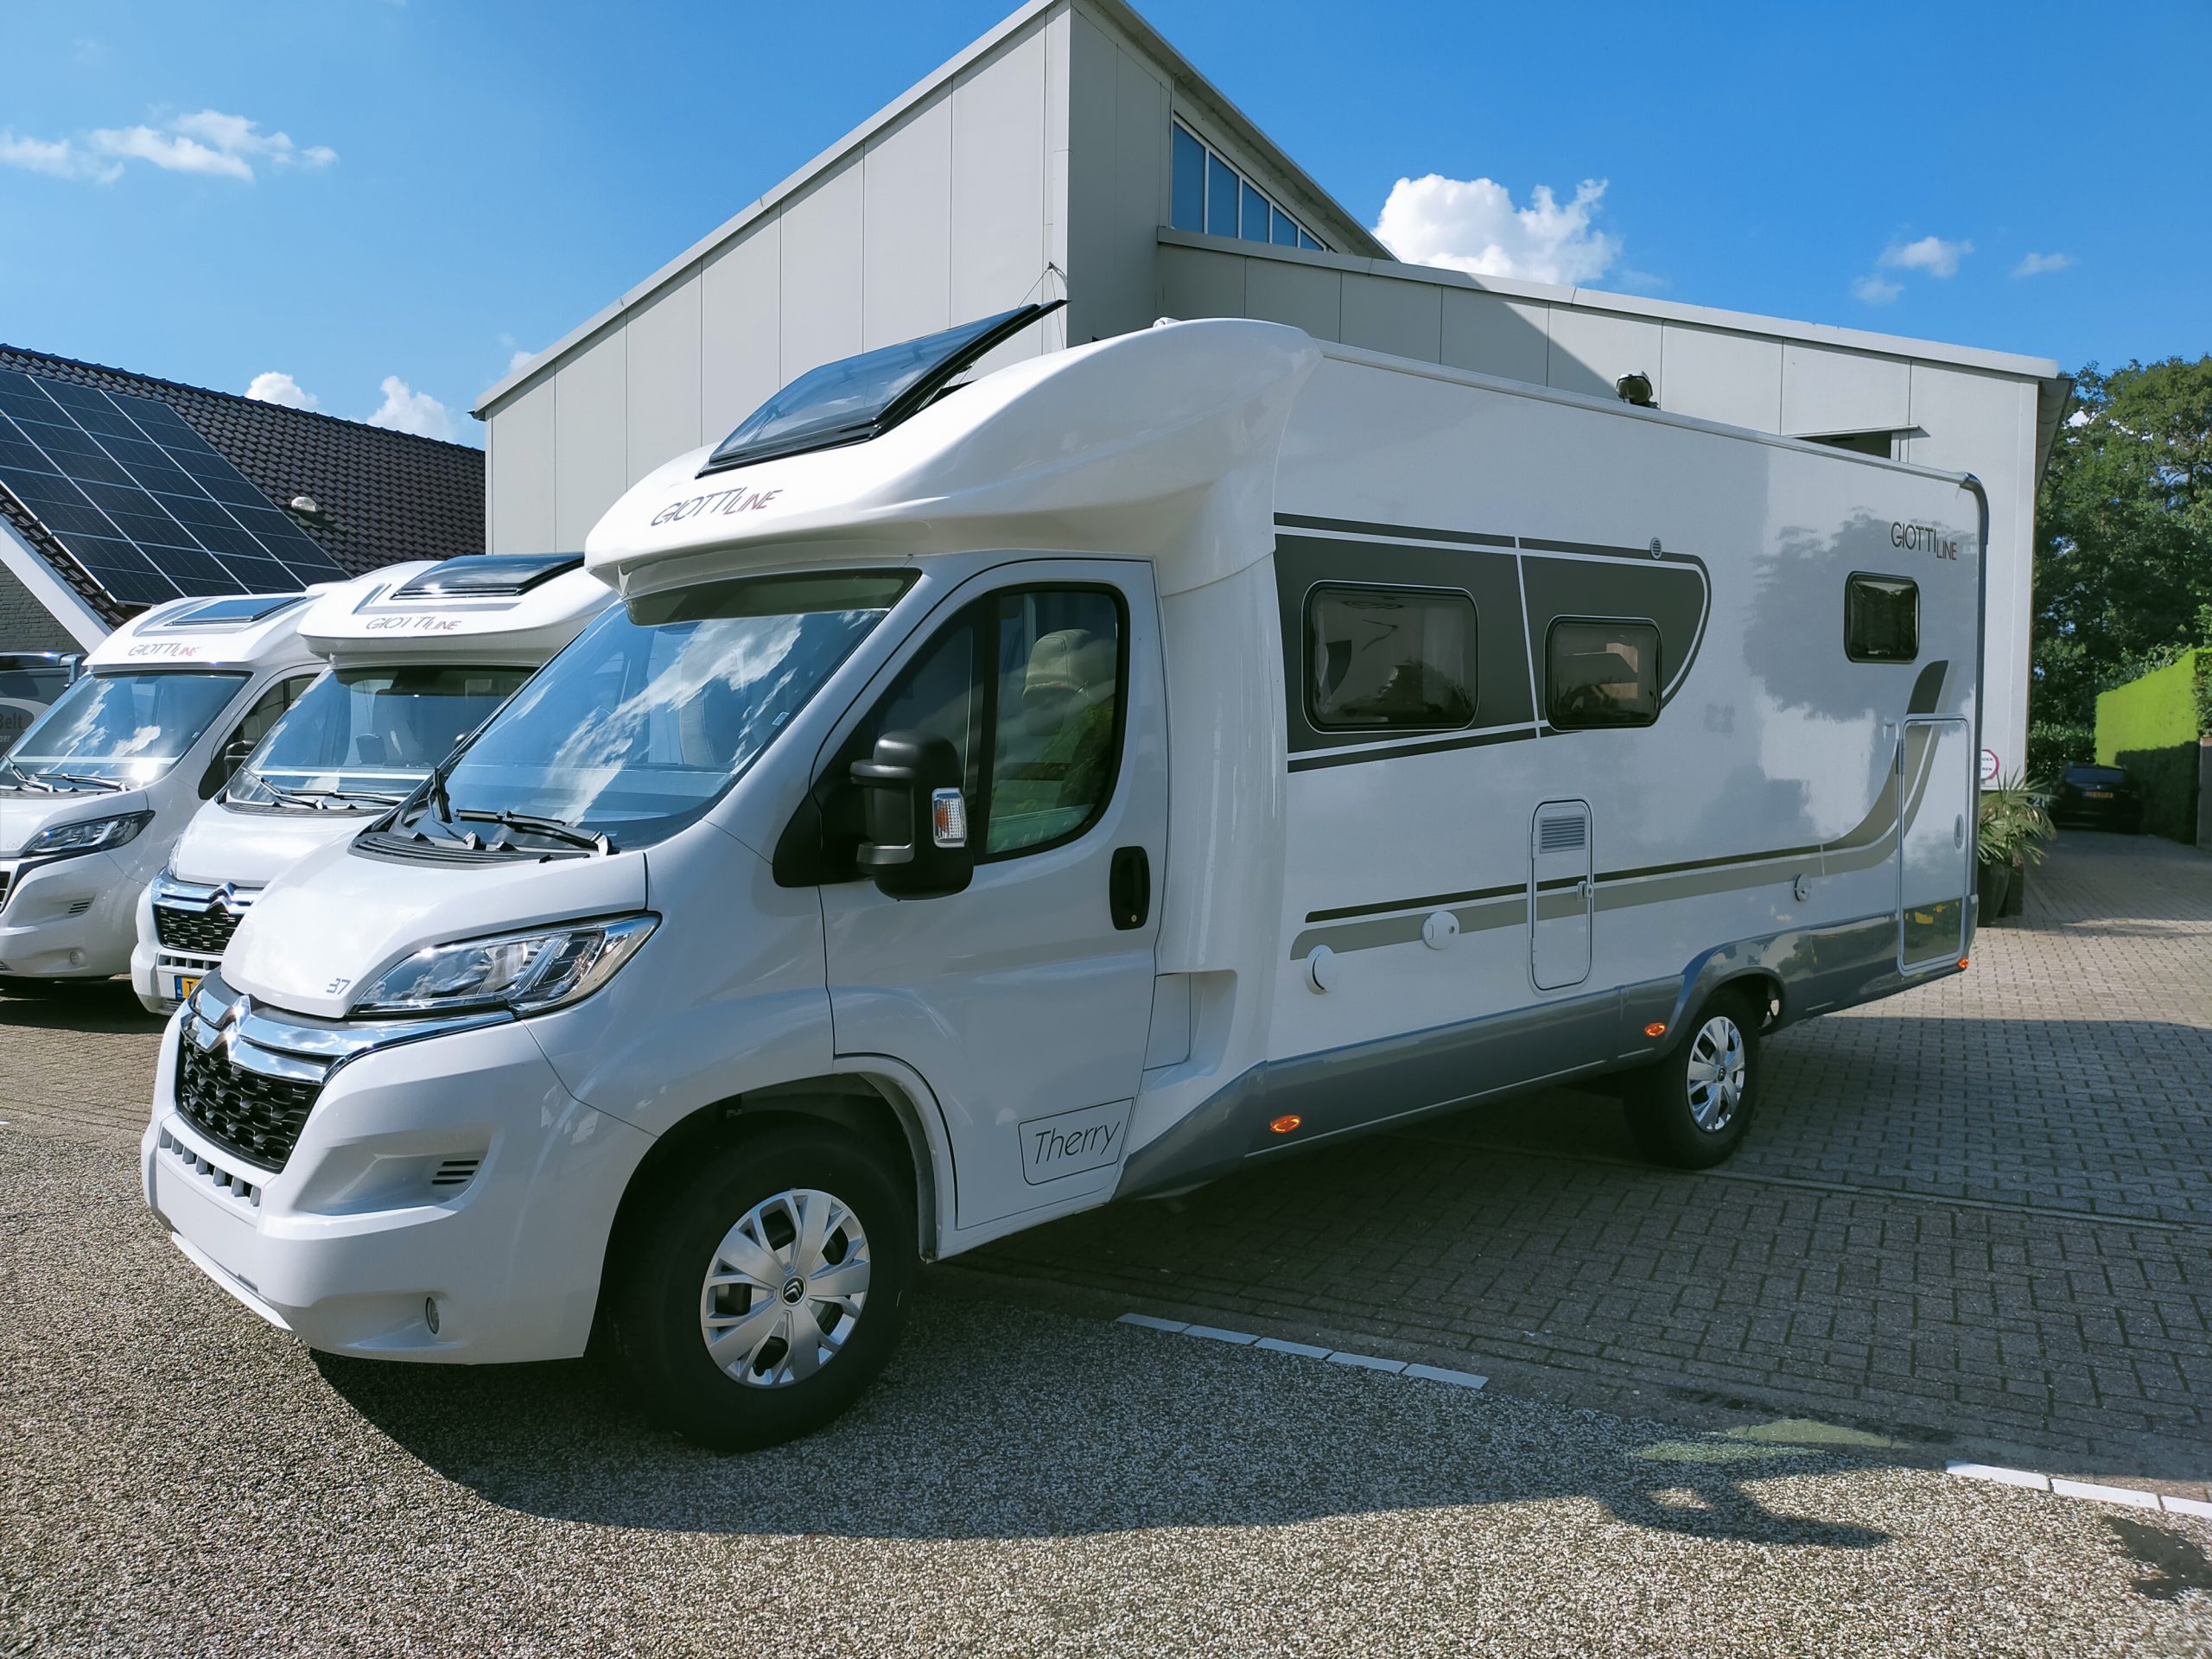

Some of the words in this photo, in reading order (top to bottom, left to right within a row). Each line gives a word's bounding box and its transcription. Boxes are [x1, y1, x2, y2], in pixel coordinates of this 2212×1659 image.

[651, 486, 784, 526] GIOTTILINE
[1891, 521, 1956, 561] GIOTTILINE
[326, 978, 352, 995] 37
[1036, 1122, 1120, 1164] Therry
